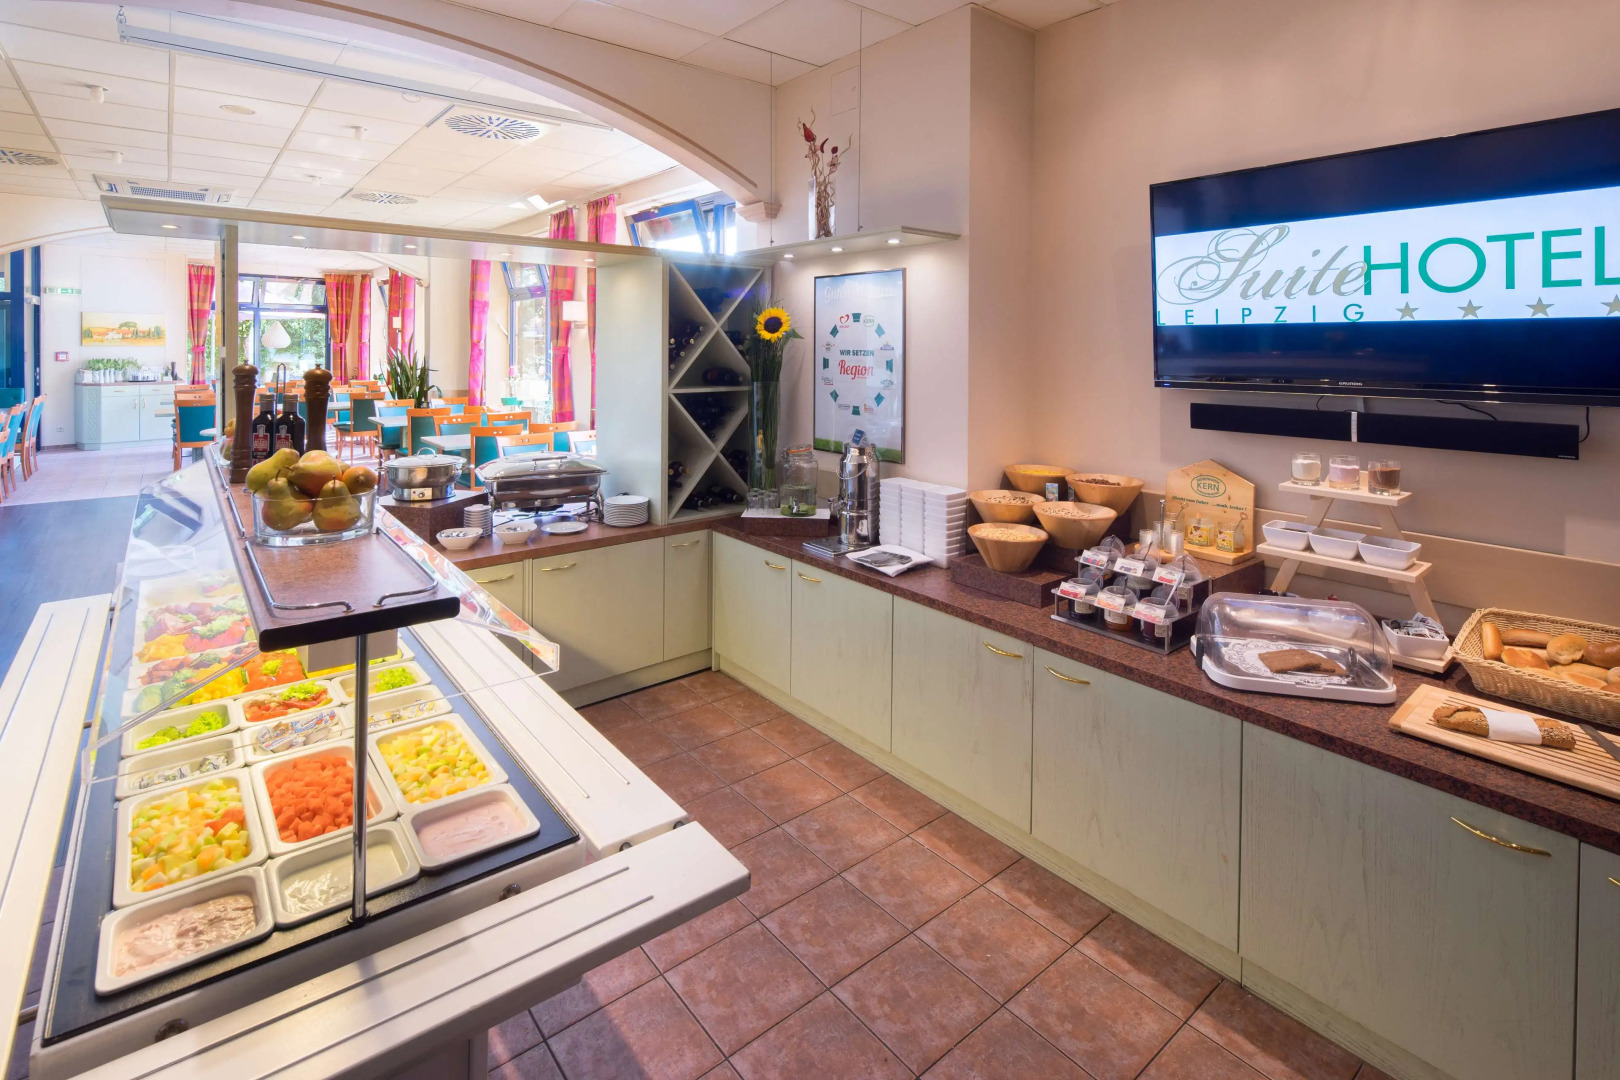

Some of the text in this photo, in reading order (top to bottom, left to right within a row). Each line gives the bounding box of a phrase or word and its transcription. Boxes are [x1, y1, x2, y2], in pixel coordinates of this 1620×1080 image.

[1156, 224, 1620, 305] Suite HOTEL
[1157, 303, 1365, 326] LEIPZIG
[851, 349, 875, 357] SETZEN
[838, 359, 874, 380] Region
[1196, 481, 1220, 492] KERN
